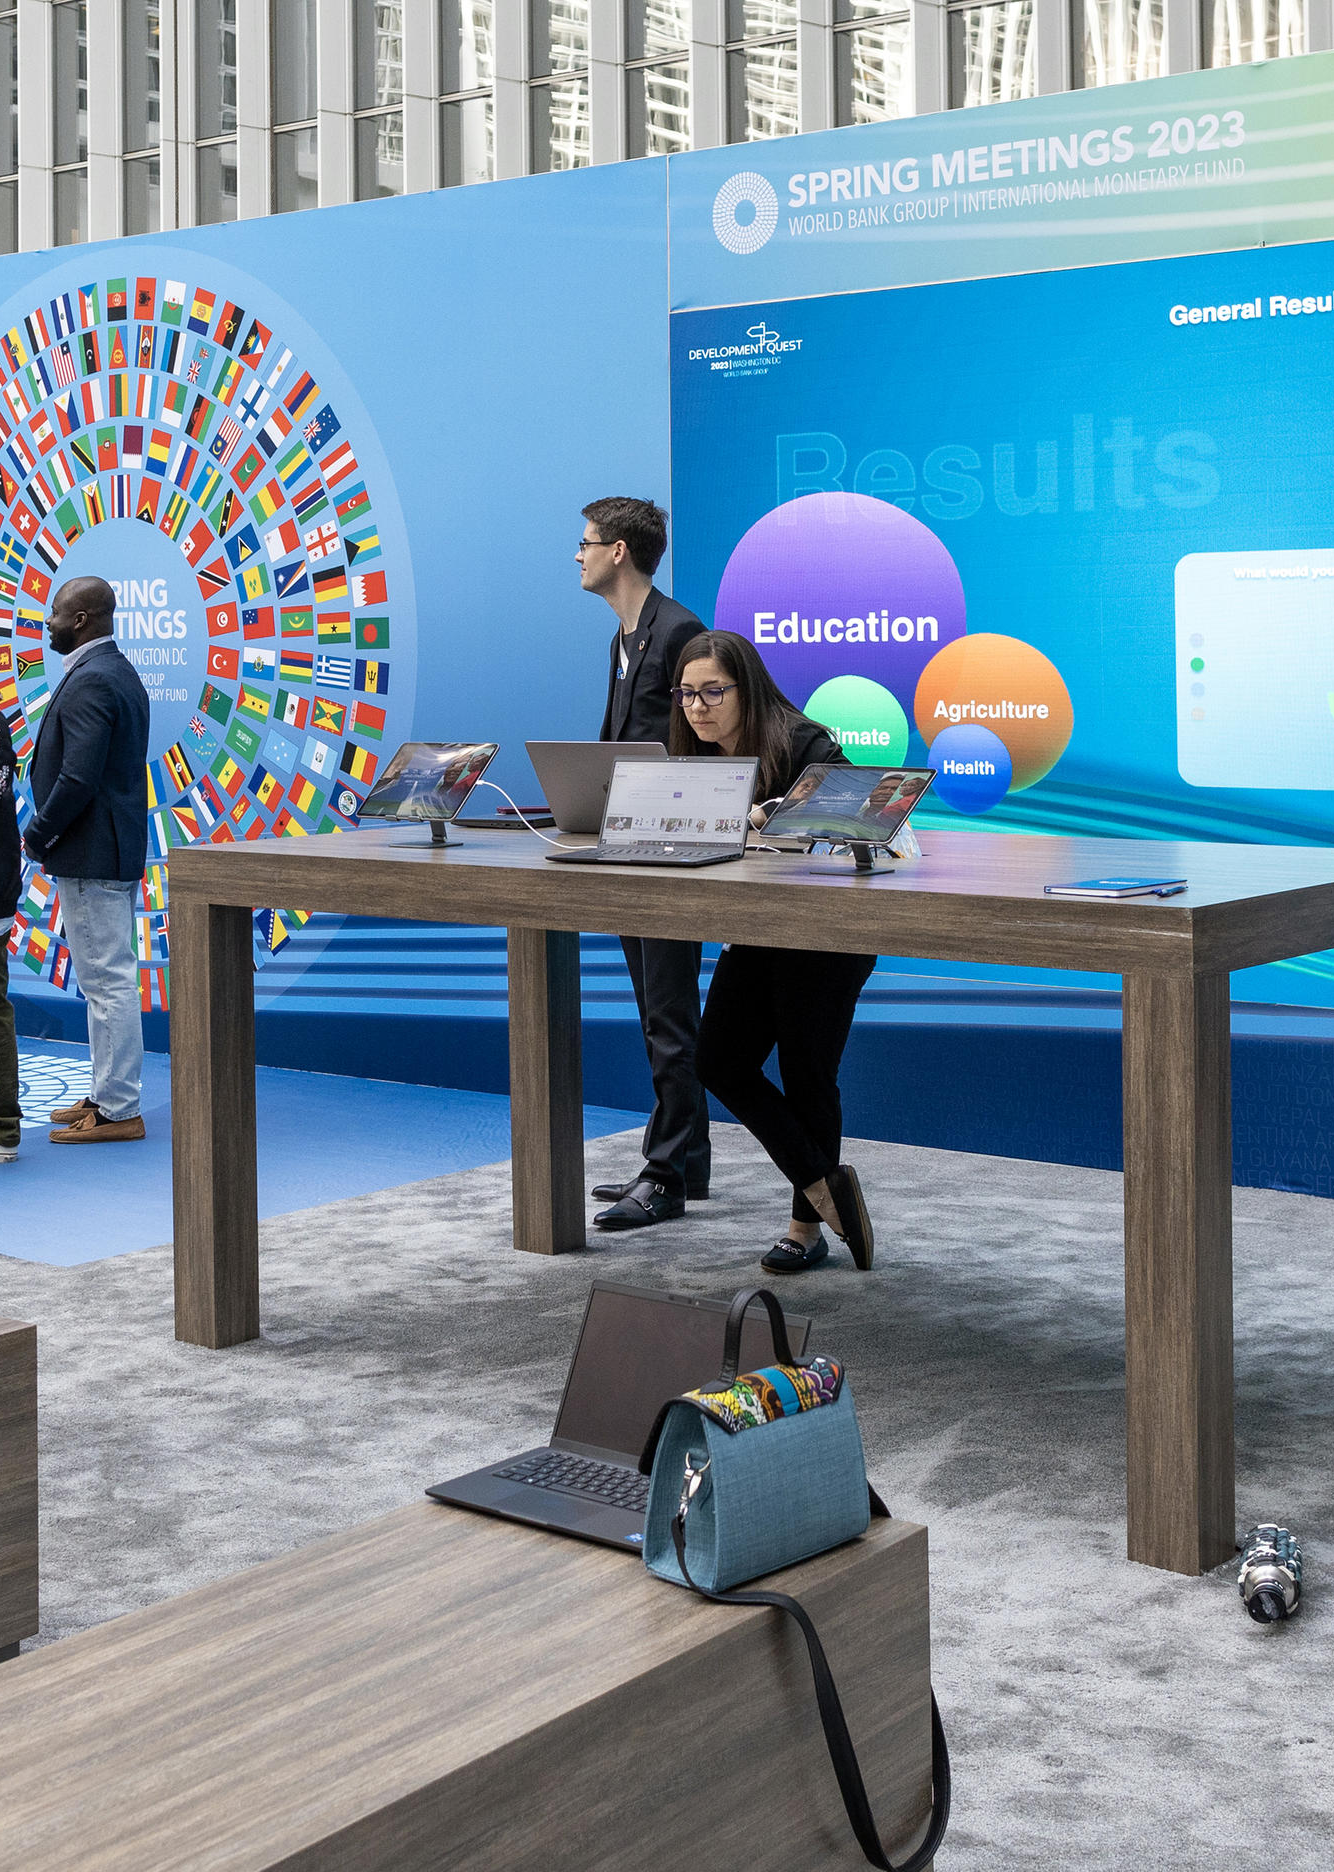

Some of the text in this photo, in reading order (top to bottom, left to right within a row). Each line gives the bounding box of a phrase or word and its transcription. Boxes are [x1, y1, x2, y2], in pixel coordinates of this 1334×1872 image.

[788, 110, 1245, 208] SPRING MEETINGS 2023
[788, 158, 1245, 236] WORLD BANK GROUP INTERNATIONAL MONETARY FUND
[1169, 297, 1262, 326] General
[689, 339, 803, 361] DEVELOPMENT QUEST
[710, 361, 729, 370] 2023
[776, 414, 1223, 527] Results
[1234, 567, 1265, 579] What
[1268, 566, 1308, 578] would
[753, 609, 940, 645] Education
[172, 648, 187, 665] DC
[166, 688, 187, 702] FUND
[932, 698, 1050, 725] Agriculture
[942, 758, 995, 777] Health
